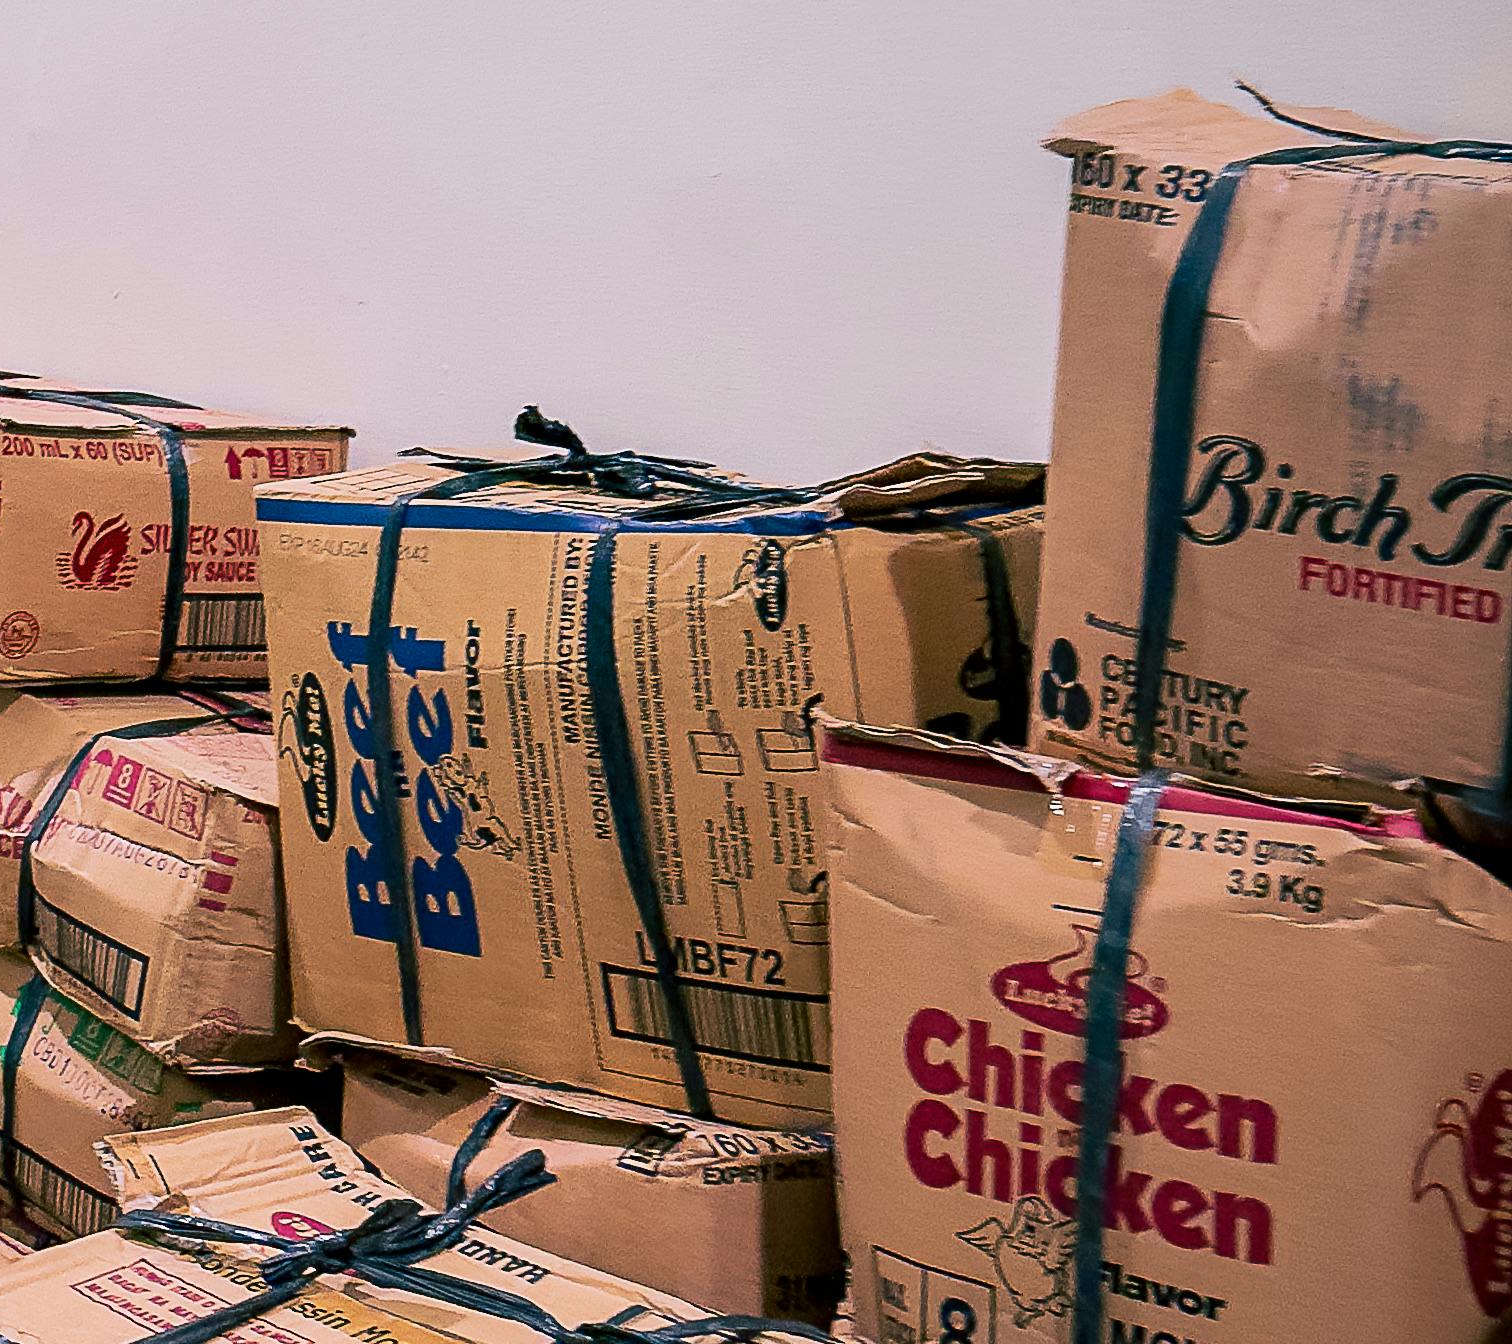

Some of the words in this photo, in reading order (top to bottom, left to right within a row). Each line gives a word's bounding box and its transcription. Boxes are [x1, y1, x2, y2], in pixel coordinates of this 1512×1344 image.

[1, 435, 35, 458] 200
[39, 438, 69, 460] mL
[71, 444, 85, 461] x
[87, 440, 108, 461] 60
[1180, 434, 1412, 562] Birch
[139, 523, 218, 556] SILER
[204, 560, 257, 583] SAUCE
[1297, 555, 1503, 625] FORTIFIED
[466, 618, 489, 749] Flavor
[1101, 654, 1250, 715] CETURY
[1101, 685, 1249, 750] PAIFIC
[327, 618, 397, 946] Beef
[389, 624, 483, 958] Beef
[1152, 820, 1184, 849] 72
[1189, 831, 1209, 853] x
[1213, 828, 1251, 857] 55
[1225, 869, 1272, 899] 3.9
[1278, 875, 1327, 913] Kg
